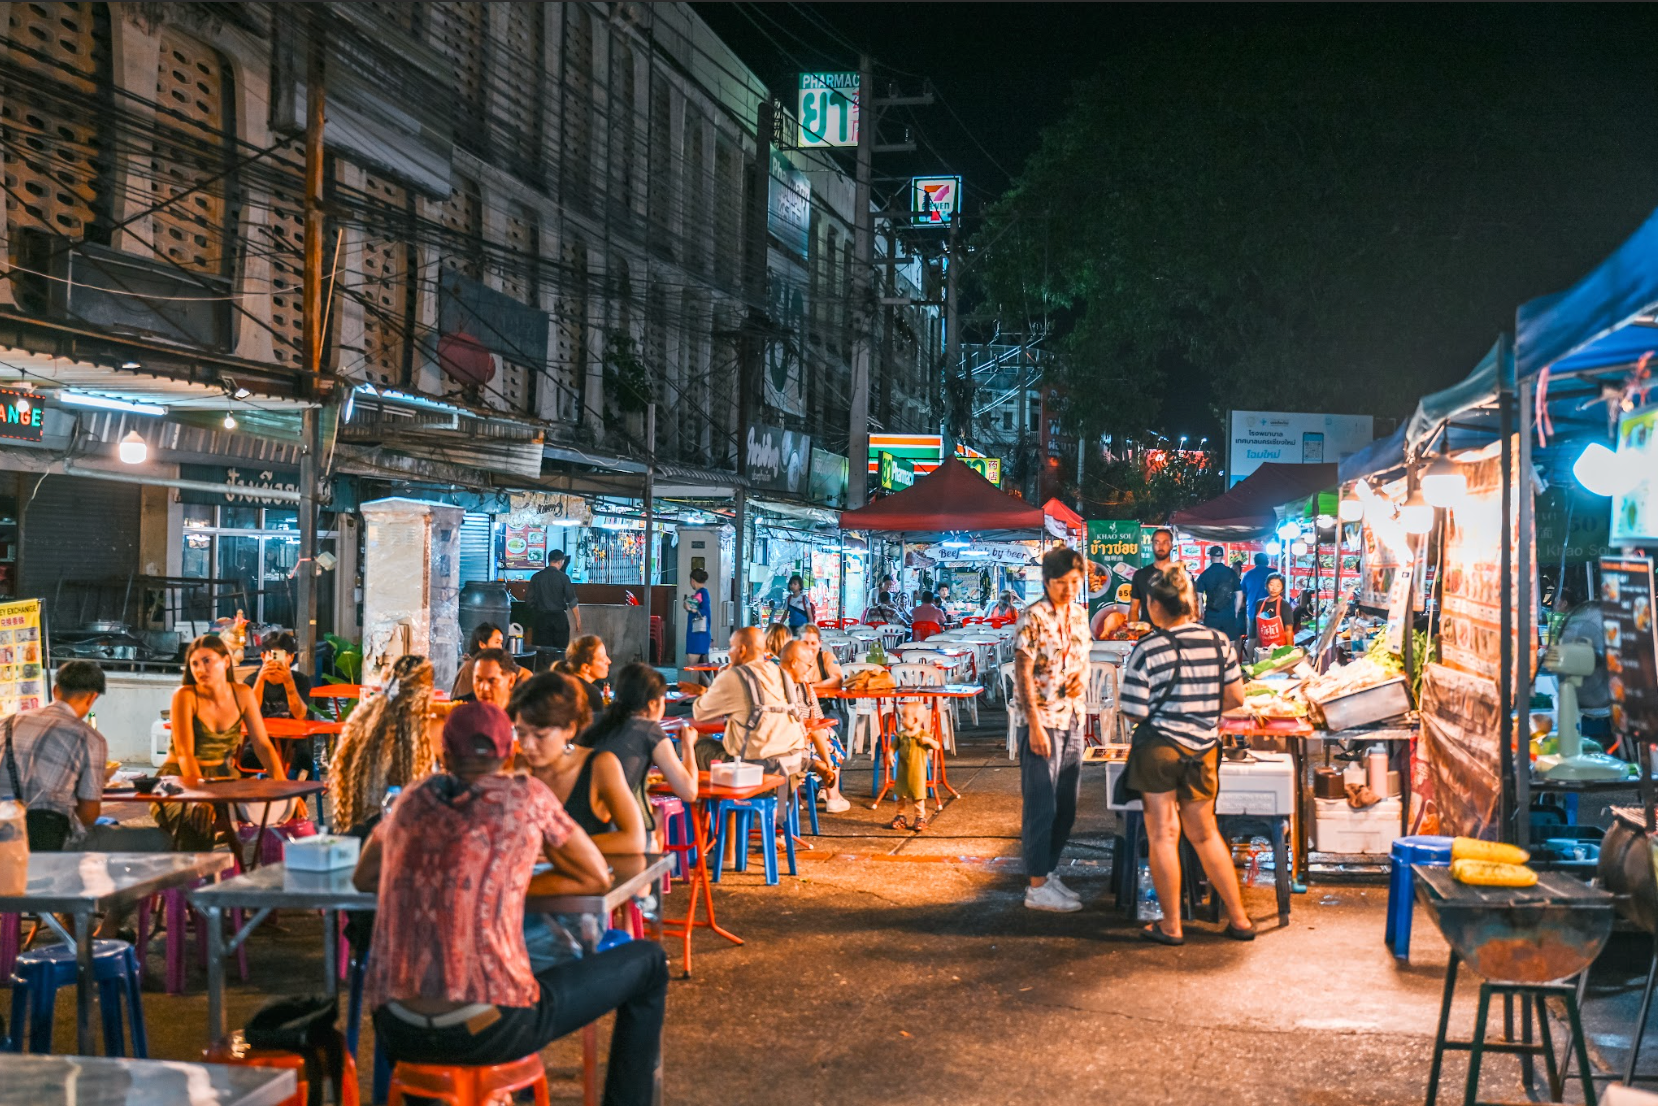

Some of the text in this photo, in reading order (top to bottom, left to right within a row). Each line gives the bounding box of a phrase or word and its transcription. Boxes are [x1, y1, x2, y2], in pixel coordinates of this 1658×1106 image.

[803, 73, 860, 89] PHARMAC
[803, 91, 848, 144] ยา
[938, 548, 960, 559] Beef
[992, 547, 1004, 559] by
